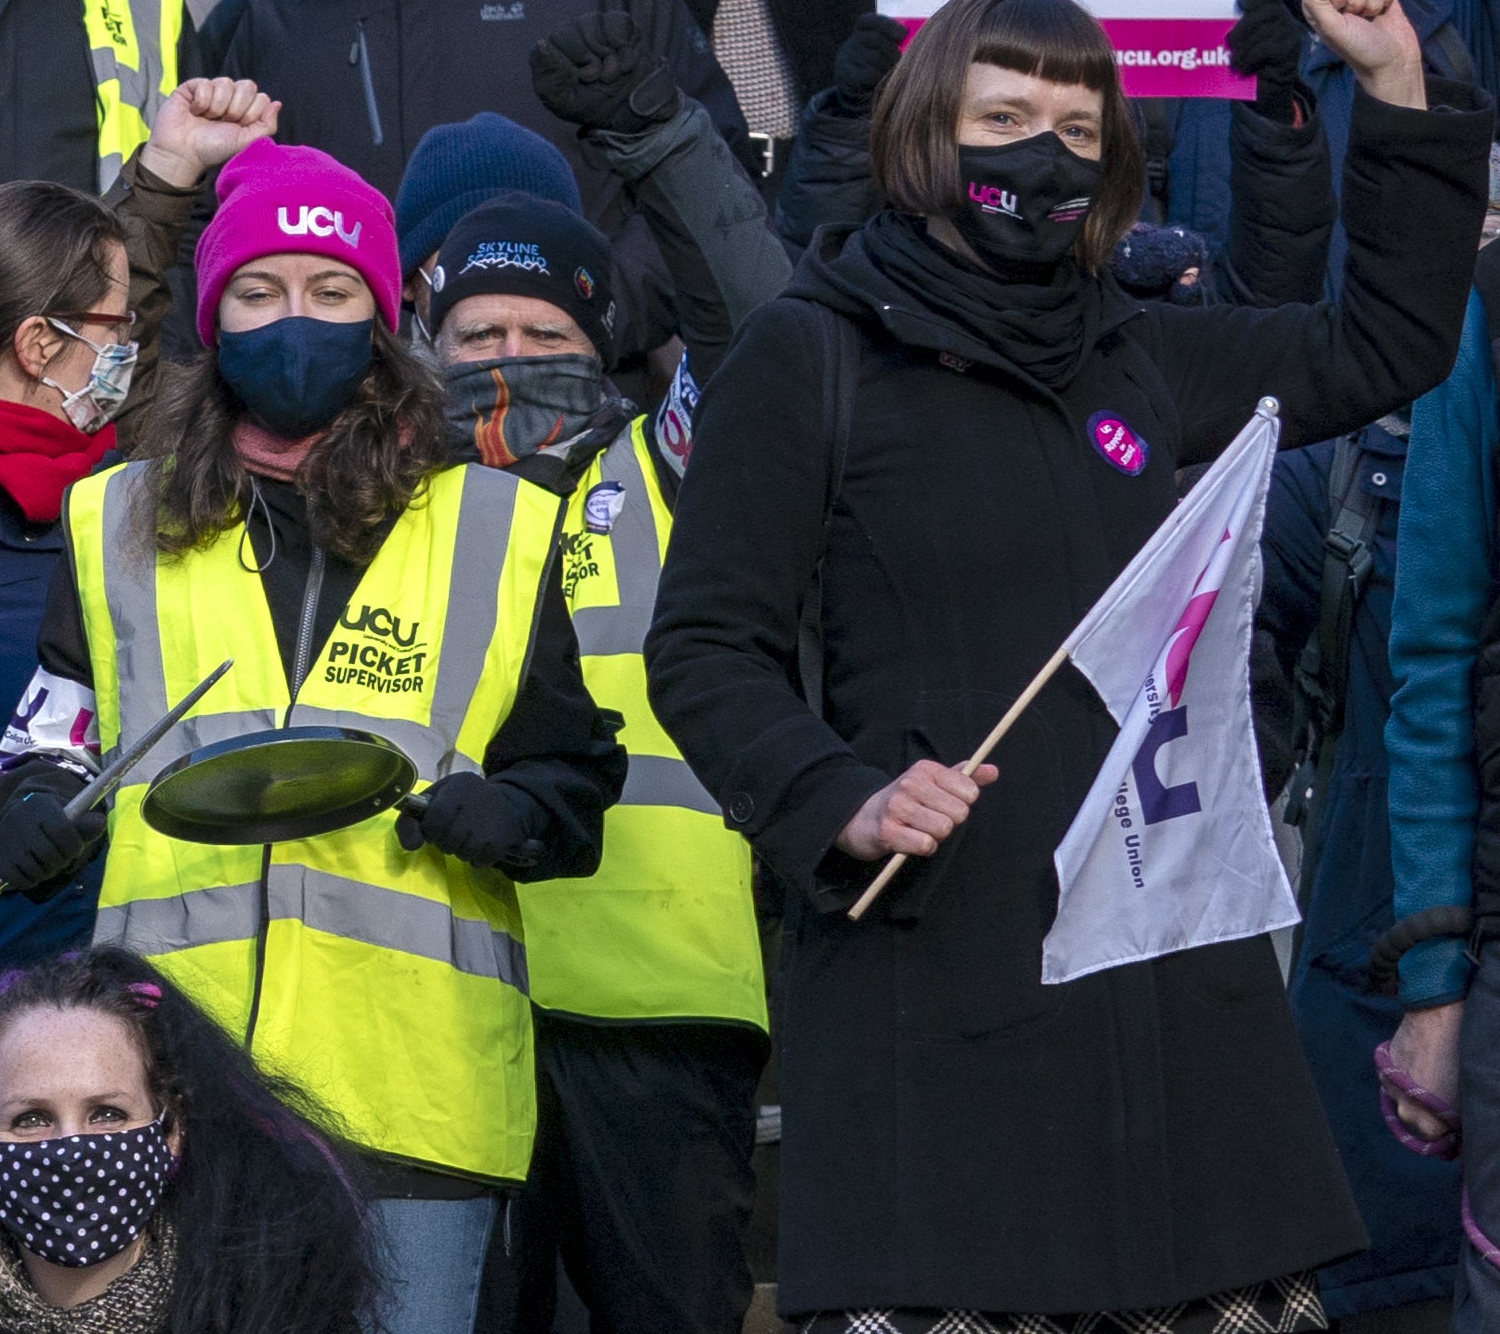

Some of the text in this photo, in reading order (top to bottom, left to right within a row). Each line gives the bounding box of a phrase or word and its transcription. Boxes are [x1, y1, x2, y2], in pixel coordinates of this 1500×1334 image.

[1112, 46, 1231, 68] ucu.org.uk
[968, 181, 1017, 213] UCU
[277, 205, 362, 249] UCU
[467, 253, 547, 270] SCOTLAND
[477, 241, 540, 257] SKYLINE
[339, 604, 420, 647] UCU
[328, 641, 427, 676] PICKET
[324, 665, 424, 693] SUPERVISOR
[1124, 833, 1145, 890] Union
